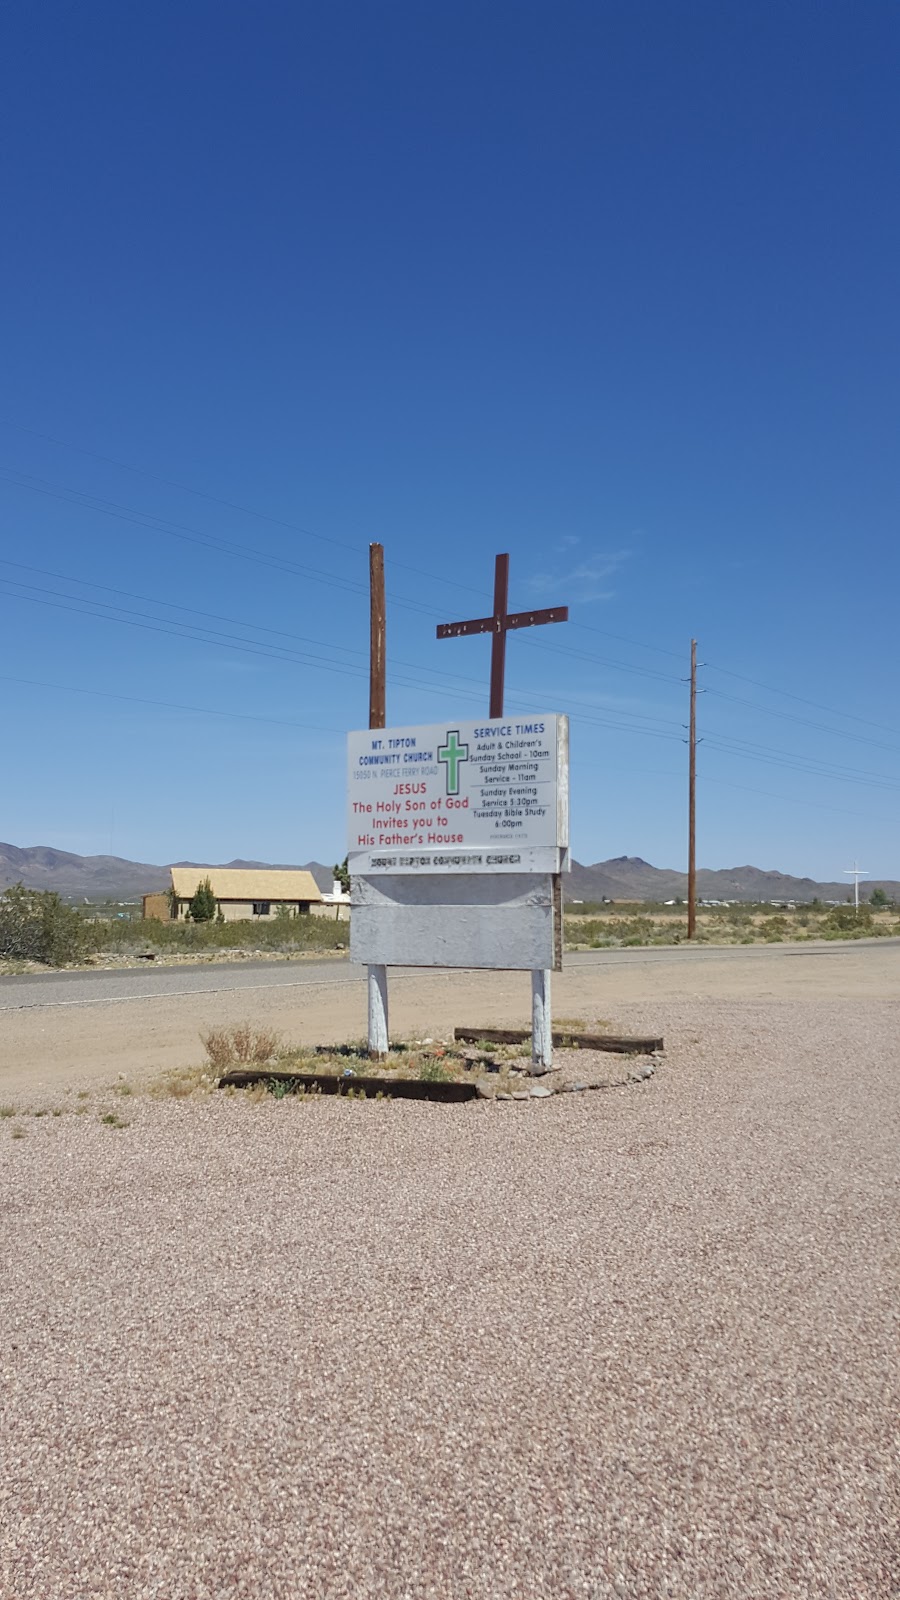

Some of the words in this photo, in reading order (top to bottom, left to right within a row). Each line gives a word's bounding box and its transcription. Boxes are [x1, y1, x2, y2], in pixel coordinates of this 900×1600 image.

[474, 726, 512, 738] SERVICE
[516, 723, 545, 734] TIMES
[372, 740, 385, 749] MT.
[388, 738, 416, 748] TIPTON
[505, 740, 541, 748] Children's
[359, 755, 400, 765] COMMUNITY
[404, 752, 433, 762] CHURCH
[498, 751, 521, 760] School
[381, 768, 400, 778] PIERCE
[402, 767, 419, 777] FERRY
[422, 766, 438, 775] ROAD
[508, 763, 538, 771] Morning
[393, 783, 426, 795] JESUS
[509, 787, 537, 795] Evening
[353, 802, 372, 813] The
[376, 800, 401, 813] Holy
[405, 800, 425, 811] Son
[430, 798, 442, 809] of
[446, 797, 469, 808] God
[482, 799, 507, 807] Service
[474, 810, 502, 818] Tuesday
[373, 817, 408, 828] Invites
[412, 819, 432, 830] you
[437, 816, 448, 825] to
[358, 834, 374, 845] His
[379, 833, 423, 844] Father's
[428, 833, 464, 843] House
